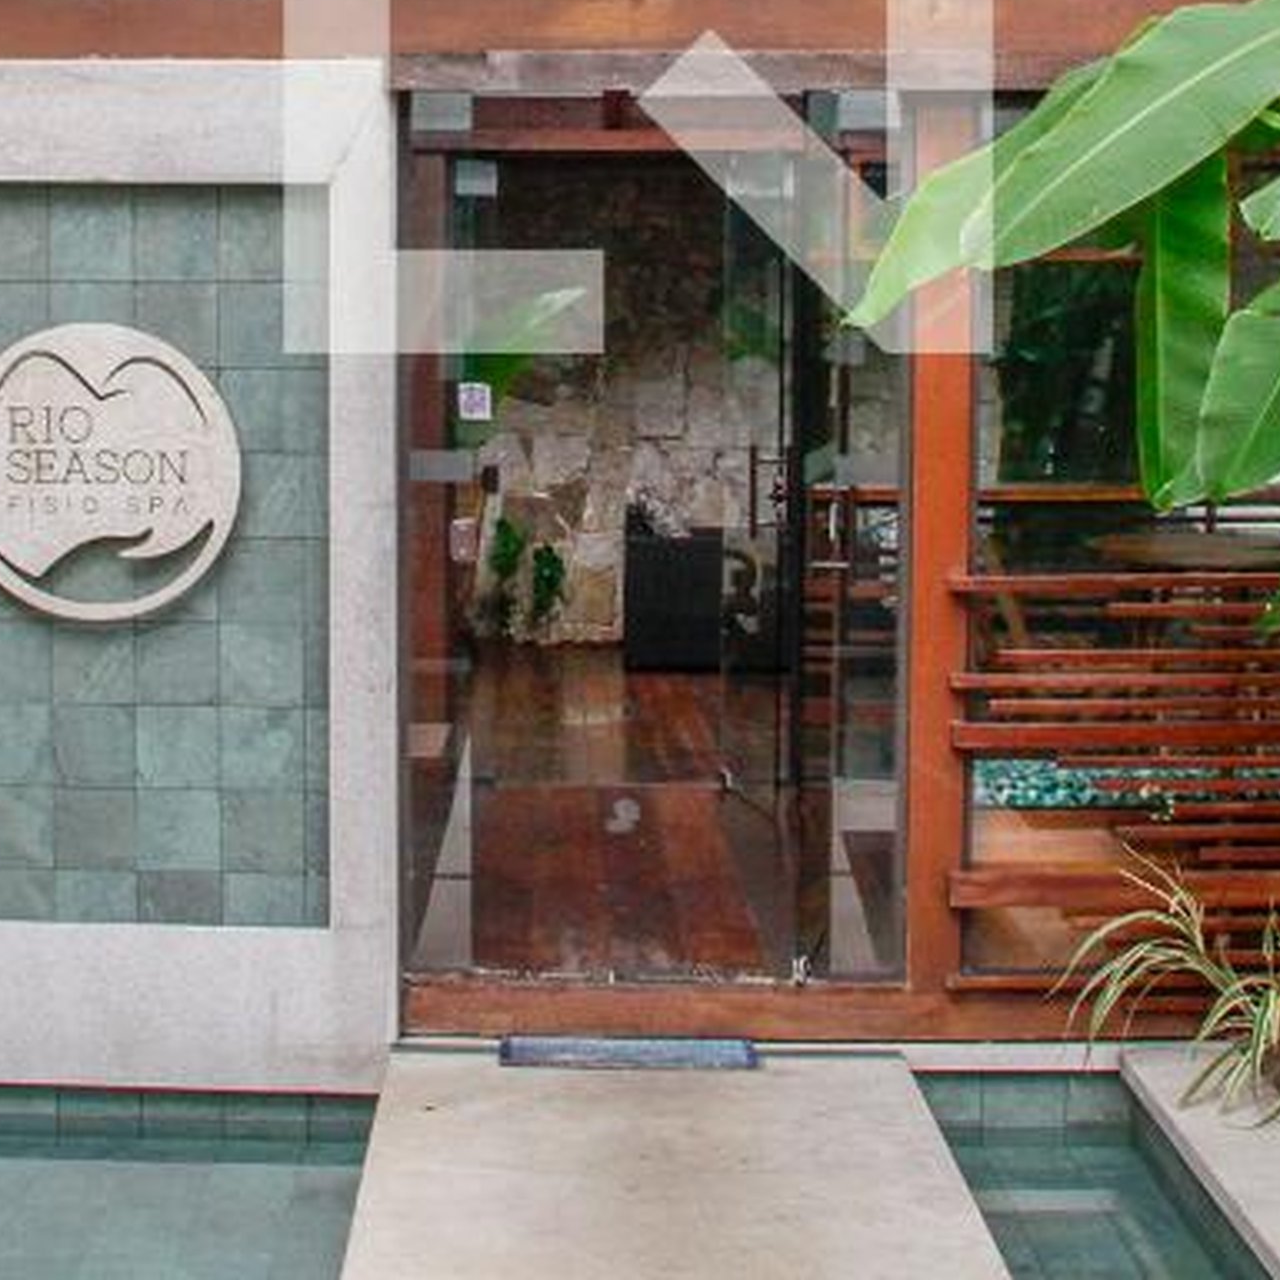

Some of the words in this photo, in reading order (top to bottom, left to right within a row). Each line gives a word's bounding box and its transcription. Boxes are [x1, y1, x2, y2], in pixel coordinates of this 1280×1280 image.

[8, 405, 93, 444] RIO
[5, 448, 189, 485] SEASON
[126, 495, 191, 515] SPA
